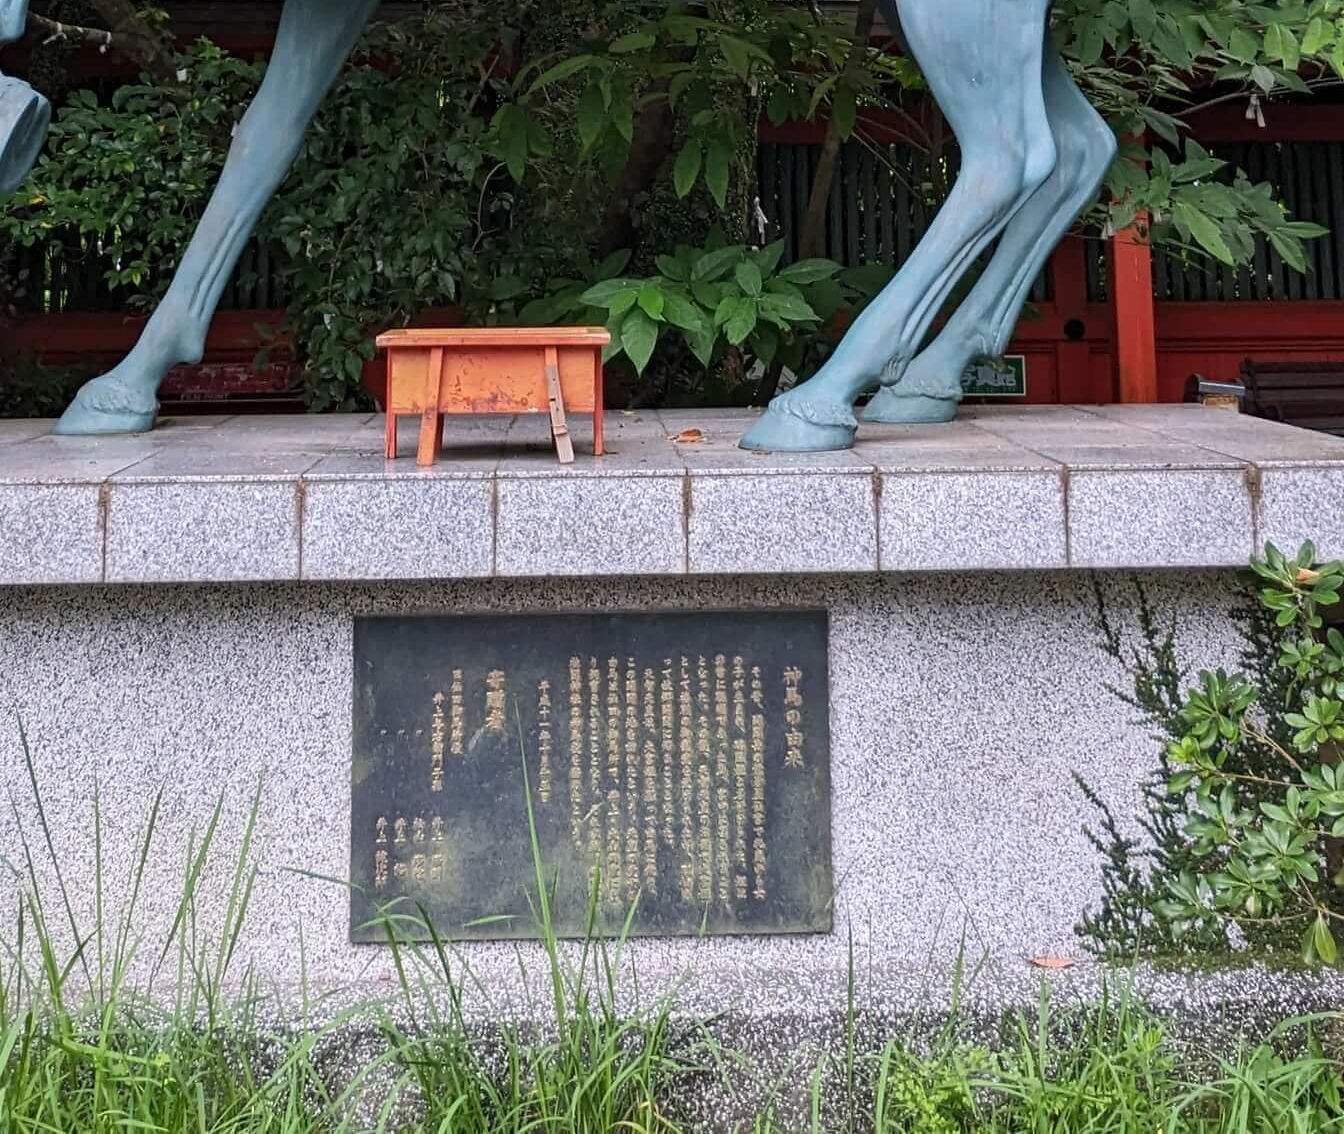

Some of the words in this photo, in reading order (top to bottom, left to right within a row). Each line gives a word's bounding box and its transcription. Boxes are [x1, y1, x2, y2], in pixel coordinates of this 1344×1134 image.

[783, 667, 804, 769] 神馬の由来
